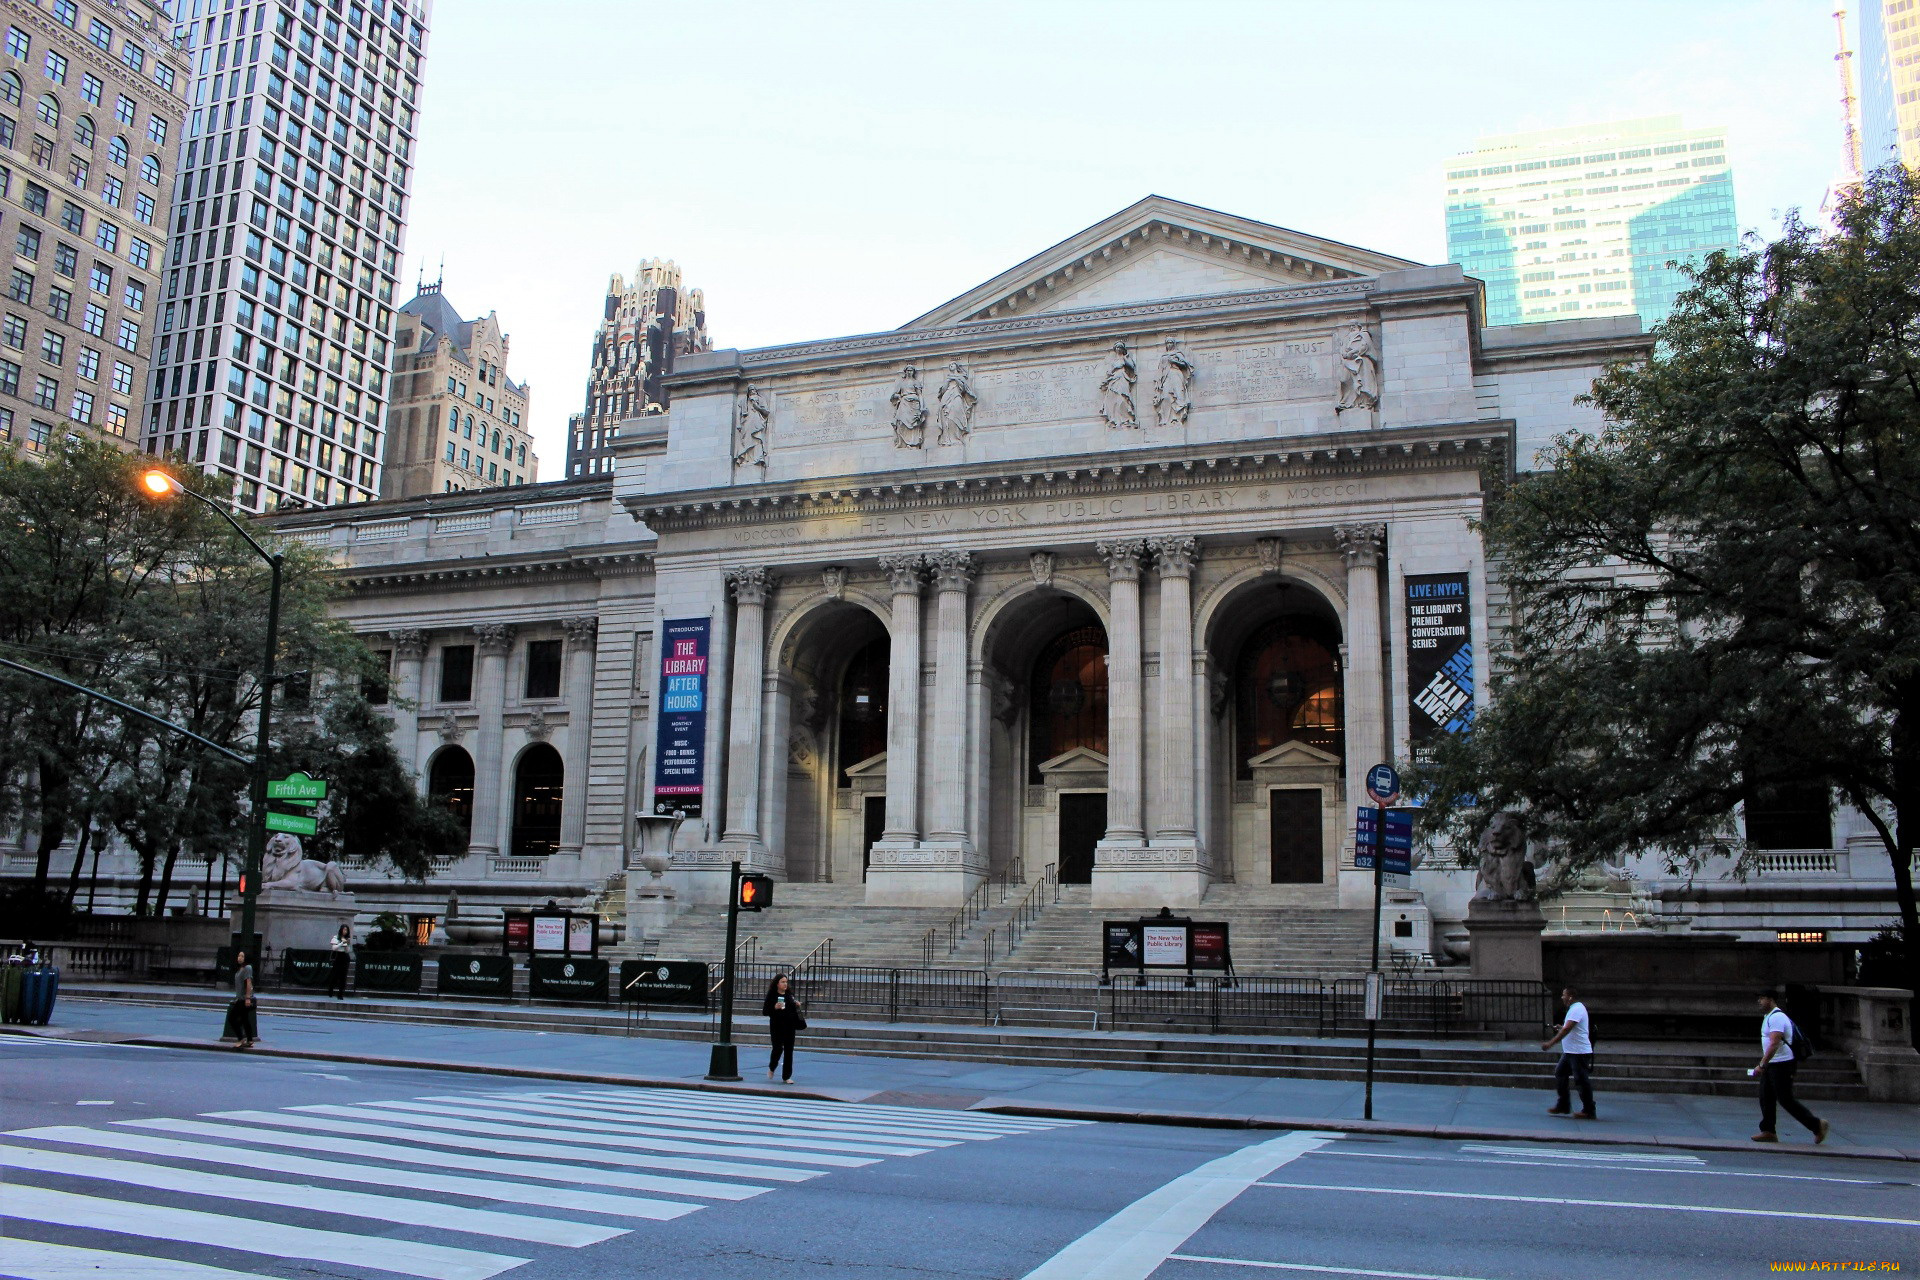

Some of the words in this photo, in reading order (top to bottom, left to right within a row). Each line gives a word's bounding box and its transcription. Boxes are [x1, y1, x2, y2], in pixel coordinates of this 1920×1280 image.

[1199, 351, 1222, 363] THE
[1233, 347, 1276, 360] TILDEN
[1285, 341, 1325, 354] TRUST
[982, 375, 1003, 385] THE
[1008, 370, 1045, 383] LENOX
[1050, 363, 1098, 379] LIBRARY
[782, 397, 802, 408] THE
[808, 392, 840, 406] ASTOR
[844, 386, 889, 401] LIBRARY
[848, 408, 873, 418] ASTOR
[843, 517, 887, 534] THE
[903, 511, 953, 530] NEW
[973, 505, 1028, 524] YORK
[1046, 499, 1123, 520] PUBLIC
[1144, 489, 1239, 512] LIBRARY
[1409, 584, 1431, 598] LIVE
[1437, 582, 1465, 596] NYPL
[1411, 606, 1425, 615] THE
[1426, 604, 1463, 614] LIBRARY'S
[1411, 616, 1443, 626] PREMIER
[668, 625, 704, 633] INTRODUCING
[1412, 626, 1465, 638] CONVERSATION
[676, 642, 694, 656] THE
[1412, 639, 1437, 649] SERIES
[665, 659, 705, 674] LIBRARY
[669, 678, 698, 691] AFTER
[1427, 670, 1468, 711] NYPL
[667, 695, 698, 709] HOURS
[1413, 687, 1449, 723] LIVE
[275, 784, 296, 795] Fifth
[299, 784, 316, 795] Ave
[1358, 809, 1368, 818] M1
[269, 816, 282, 825] John
[282, 818, 303, 829] Bigelow
[1358, 821, 1368, 830] M1
[1357, 833, 1369, 842] M4
[1356, 845, 1368, 854] M4
[1356, 857, 1372, 867] Q32
